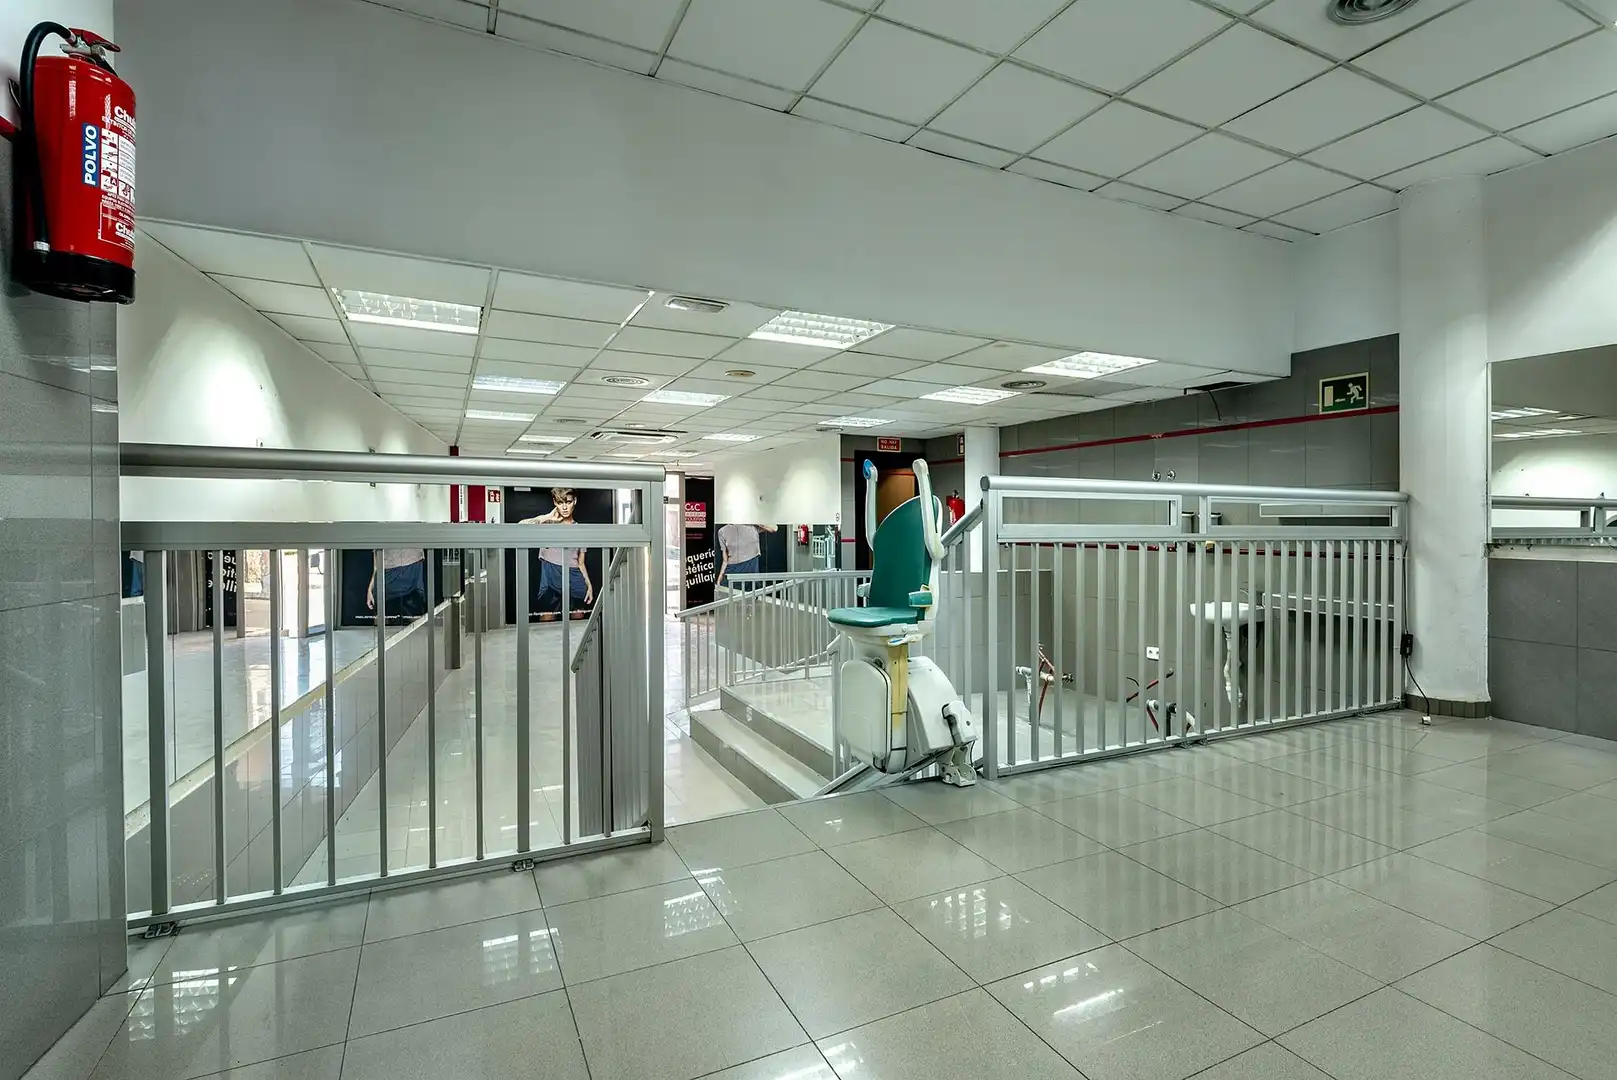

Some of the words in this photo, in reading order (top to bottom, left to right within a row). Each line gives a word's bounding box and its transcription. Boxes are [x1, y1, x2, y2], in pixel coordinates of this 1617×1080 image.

[84, 125, 97, 186] POLVO
[685, 548, 716, 564] quería
[685, 561, 714, 576] stética
[685, 571, 715, 589] quillaj
